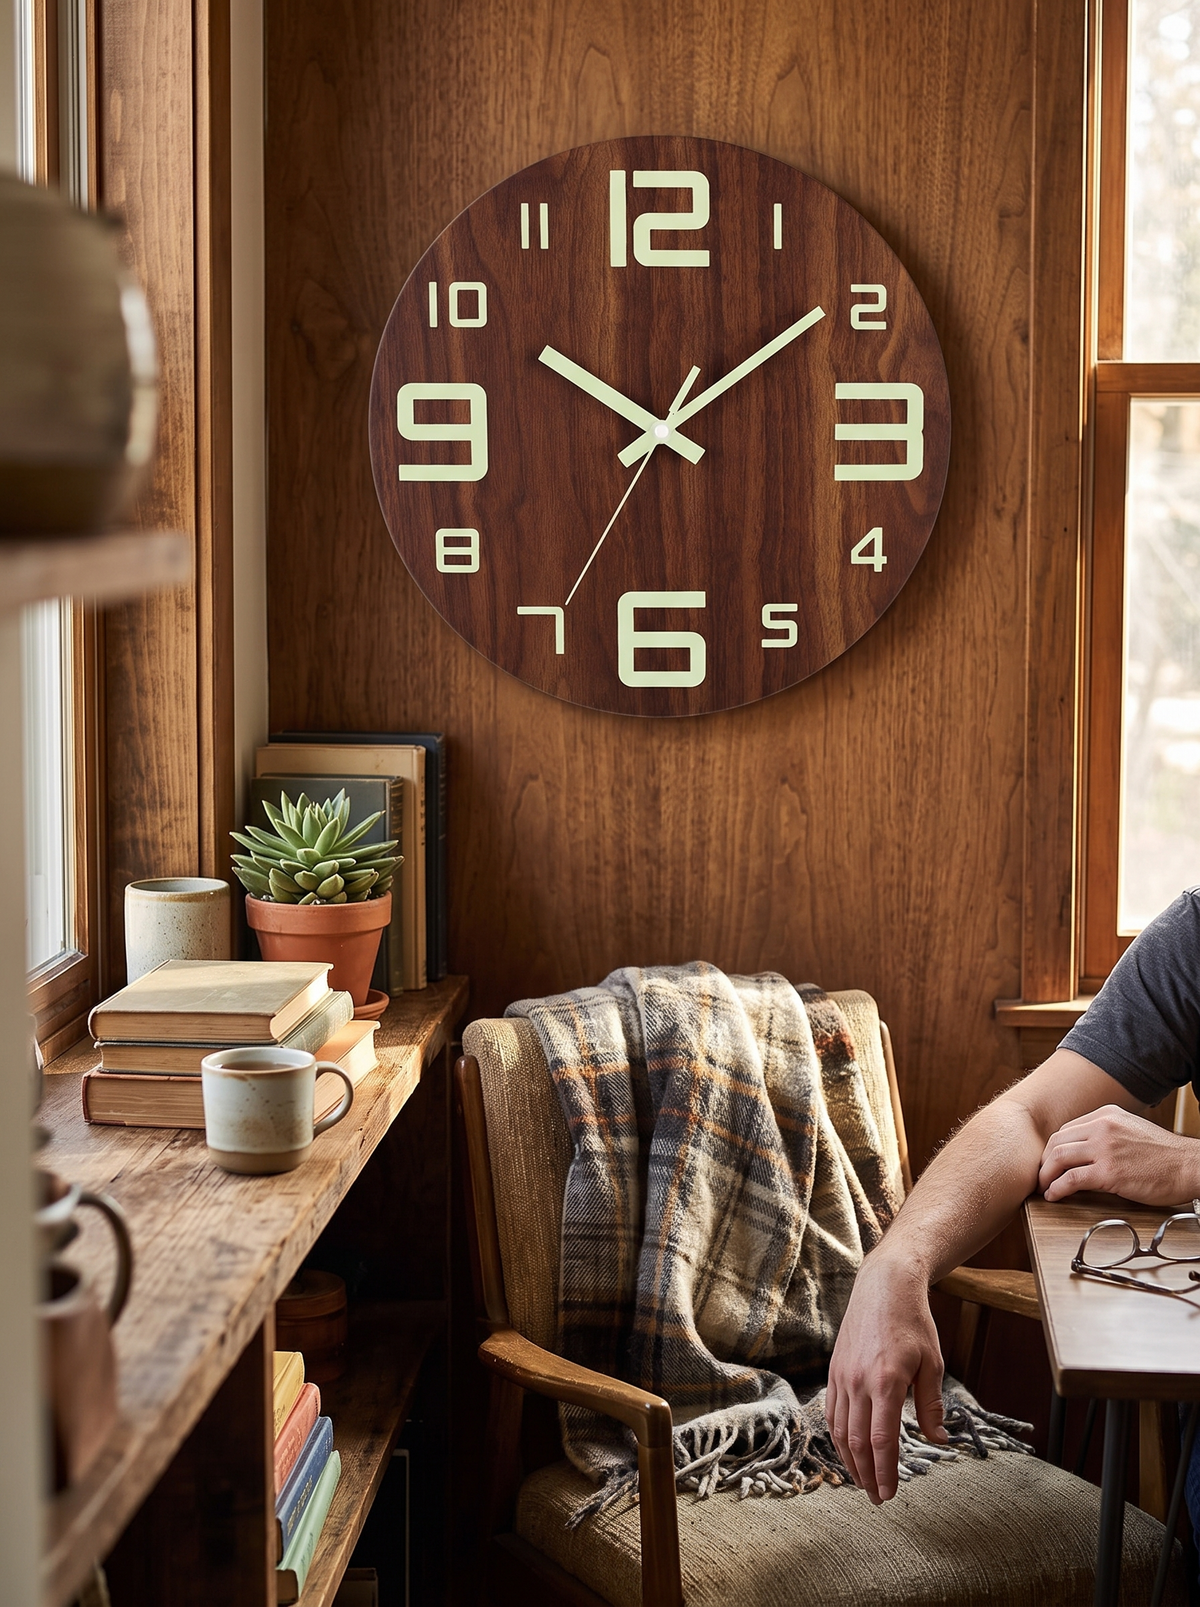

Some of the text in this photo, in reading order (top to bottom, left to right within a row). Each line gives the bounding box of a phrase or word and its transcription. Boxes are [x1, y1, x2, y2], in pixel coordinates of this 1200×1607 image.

[521, 203, 549, 249] 11
[610, 170, 709, 267] 12
[774, 203, 782, 249] 1
[429, 281, 487, 327] 10
[851, 284, 887, 329] 2
[397, 383, 488, 481] 9
[835, 383, 924, 481] 3
[436, 528, 479, 573] 8
[851, 527, 887, 572] 4
[517, 606, 564, 654] 7
[618, 591, 706, 687] 6
[761, 603, 798, 647] 5
